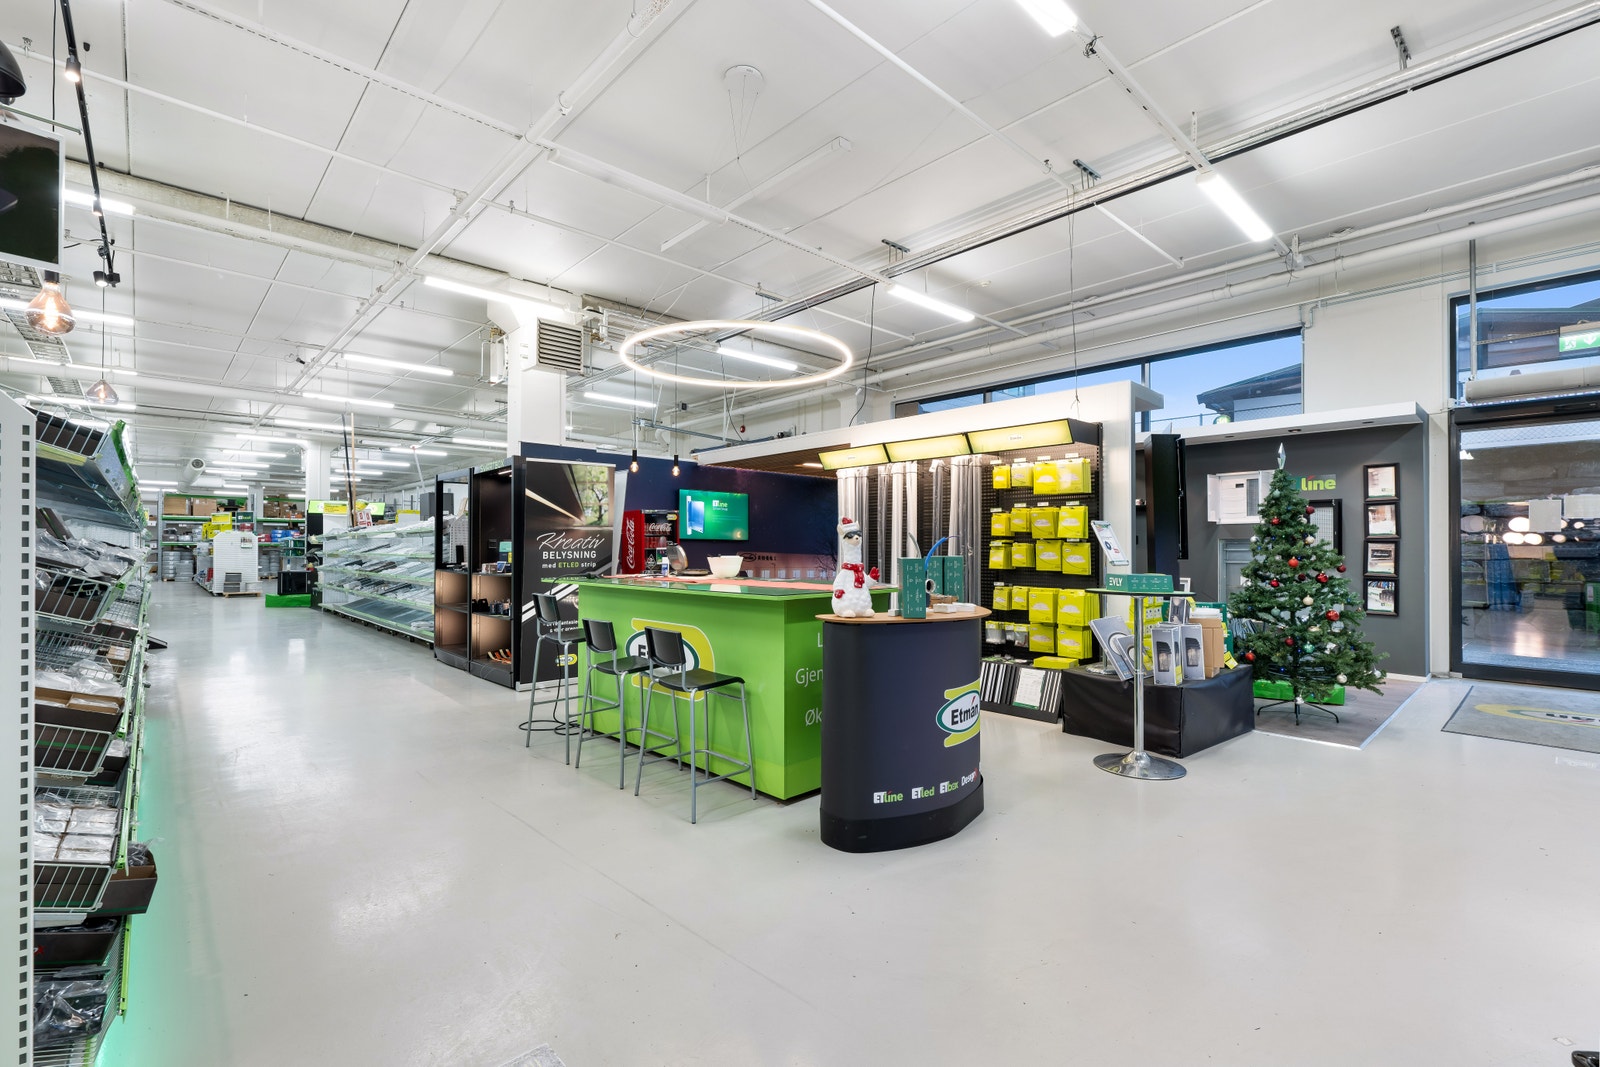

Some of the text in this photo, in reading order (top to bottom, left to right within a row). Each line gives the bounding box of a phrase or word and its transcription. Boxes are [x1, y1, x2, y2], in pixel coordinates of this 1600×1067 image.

[536, 531, 605, 550] Kreativ
[542, 550, 597, 560] BELYSNING
[558, 561, 580, 569] ETLED
[580, 561, 597, 569] strip
[911, 786, 935, 800] ETled
[939, 780, 959, 794] ETbox
